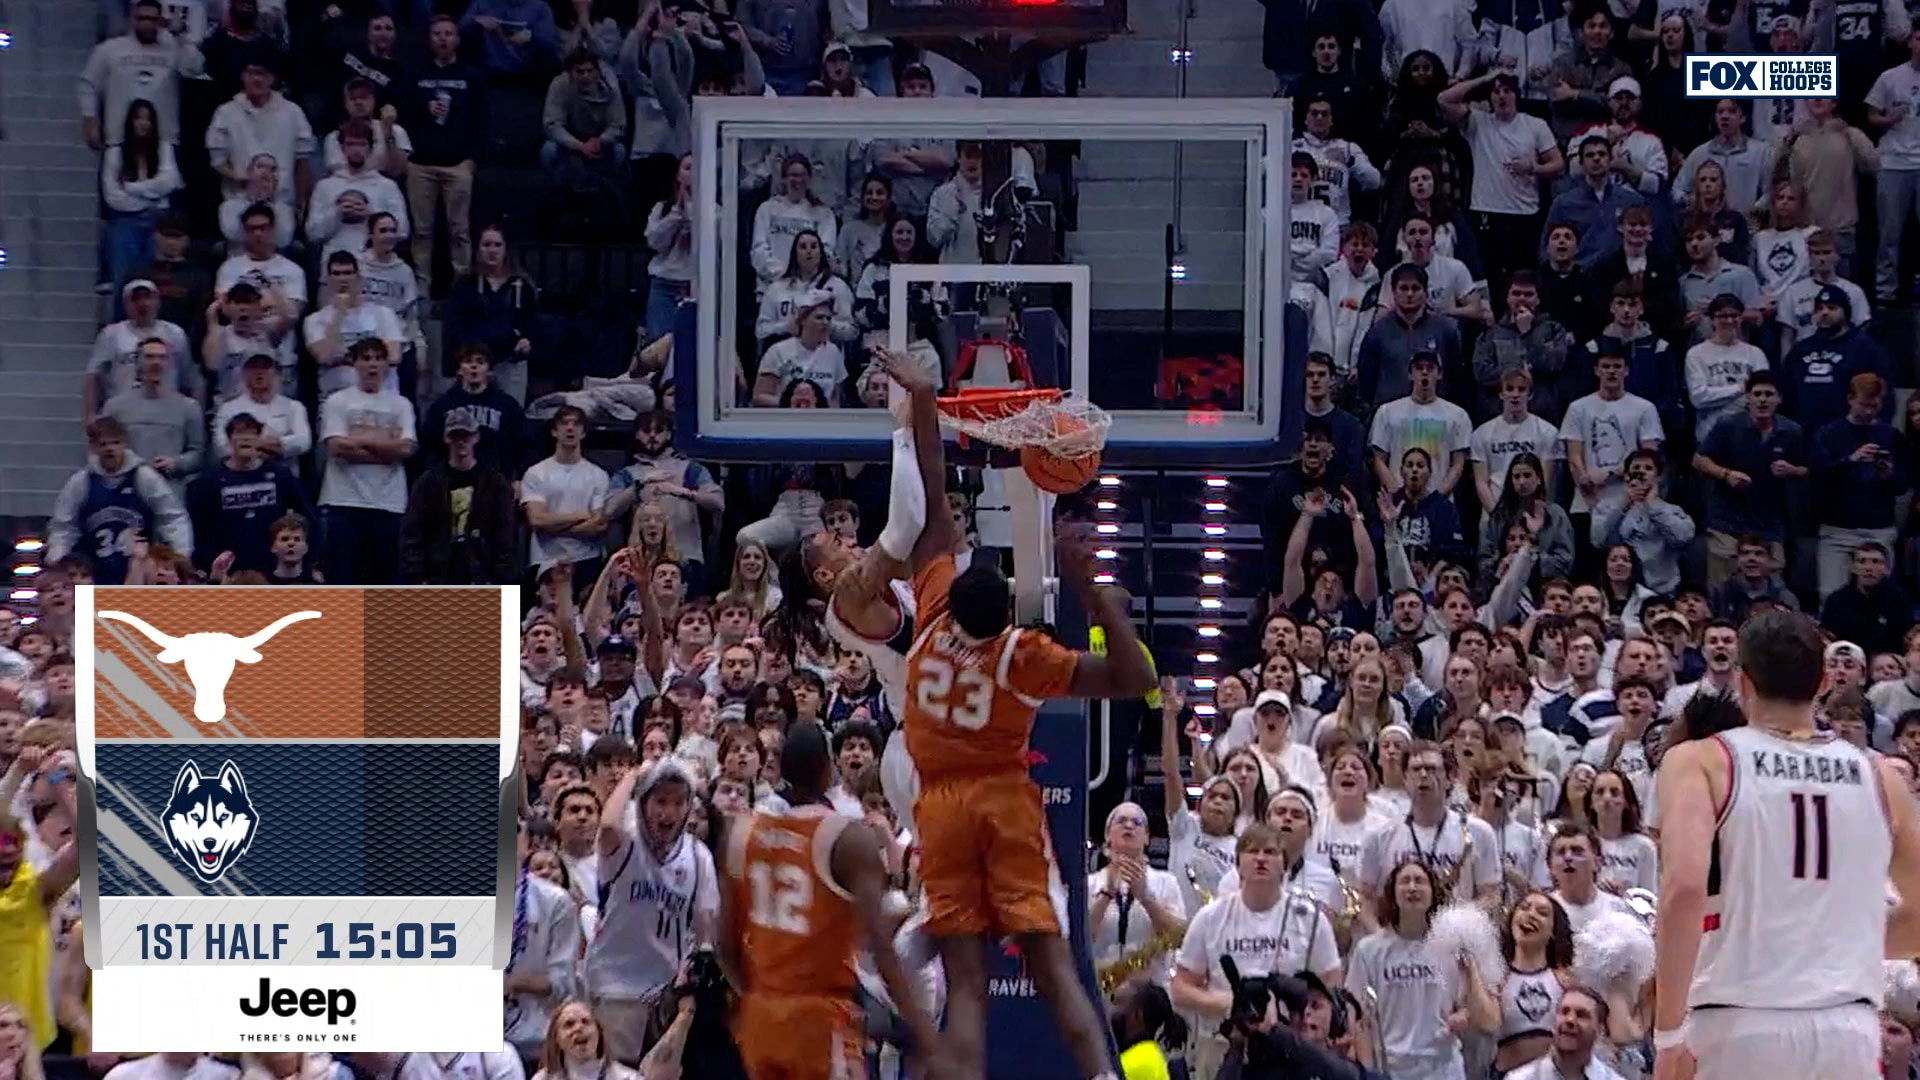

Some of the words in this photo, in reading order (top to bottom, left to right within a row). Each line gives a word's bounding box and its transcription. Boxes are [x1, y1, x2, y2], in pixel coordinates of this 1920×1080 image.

[1839, 15, 1871, 40] 34
[918, 656, 992, 730] 23
[1753, 752, 1861, 785] KARABAN
[1791, 793, 1828, 879] 11
[750, 860, 813, 935] 12
